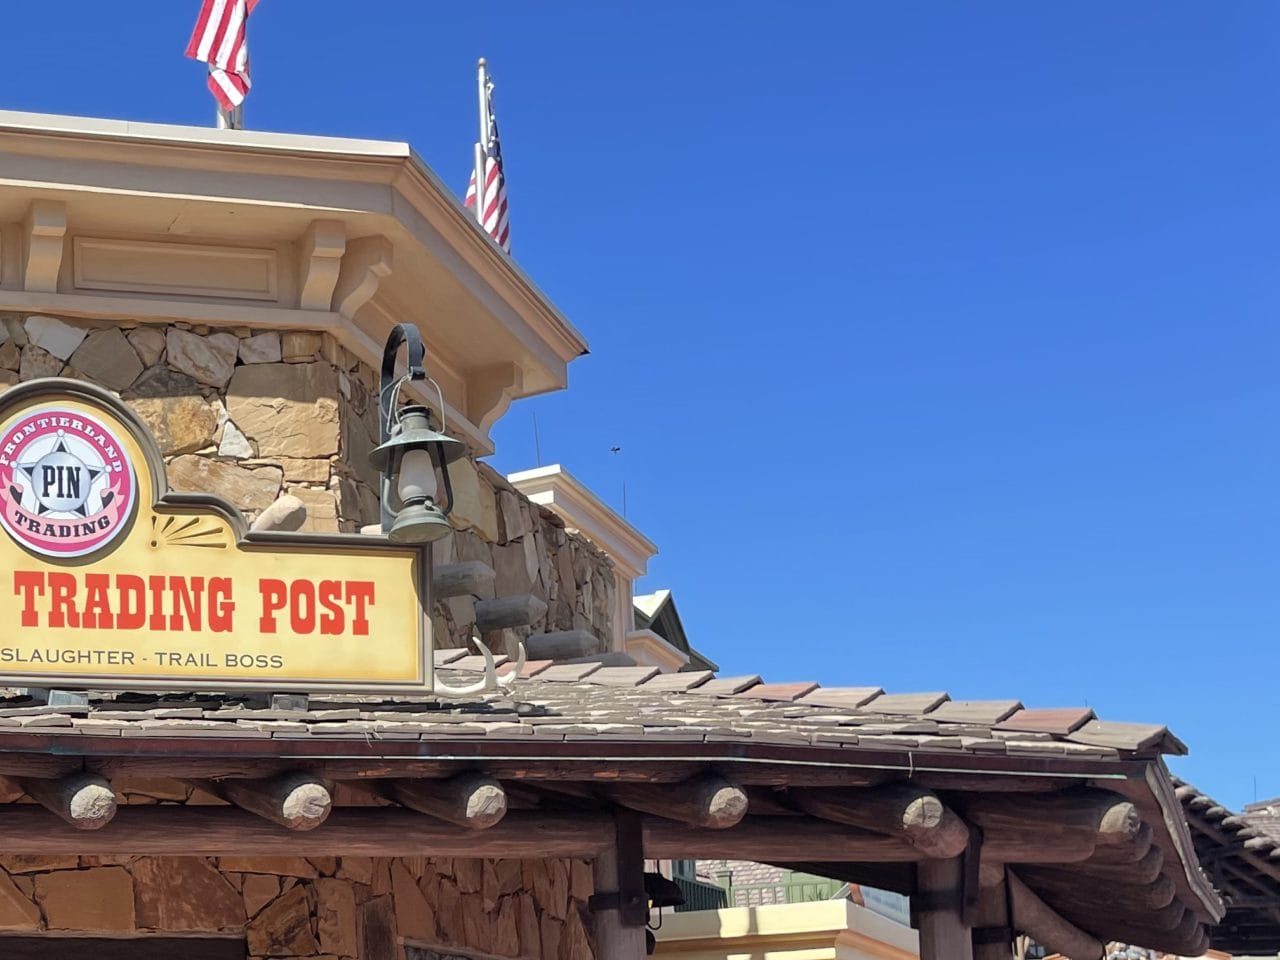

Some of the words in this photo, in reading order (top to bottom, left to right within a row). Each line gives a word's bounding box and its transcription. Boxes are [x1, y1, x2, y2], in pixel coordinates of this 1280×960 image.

[0, 417, 123, 473] FRONTIERLAND
[41, 465, 81, 499] PIN
[14, 510, 111, 538] TRADING
[13, 570, 236, 633] TRADING
[258, 577, 376, 636] POST
[0, 647, 135, 666] SLAUGHTER
[154, 651, 219, 668] TRAIL
[225, 653, 284, 669] BOSS
